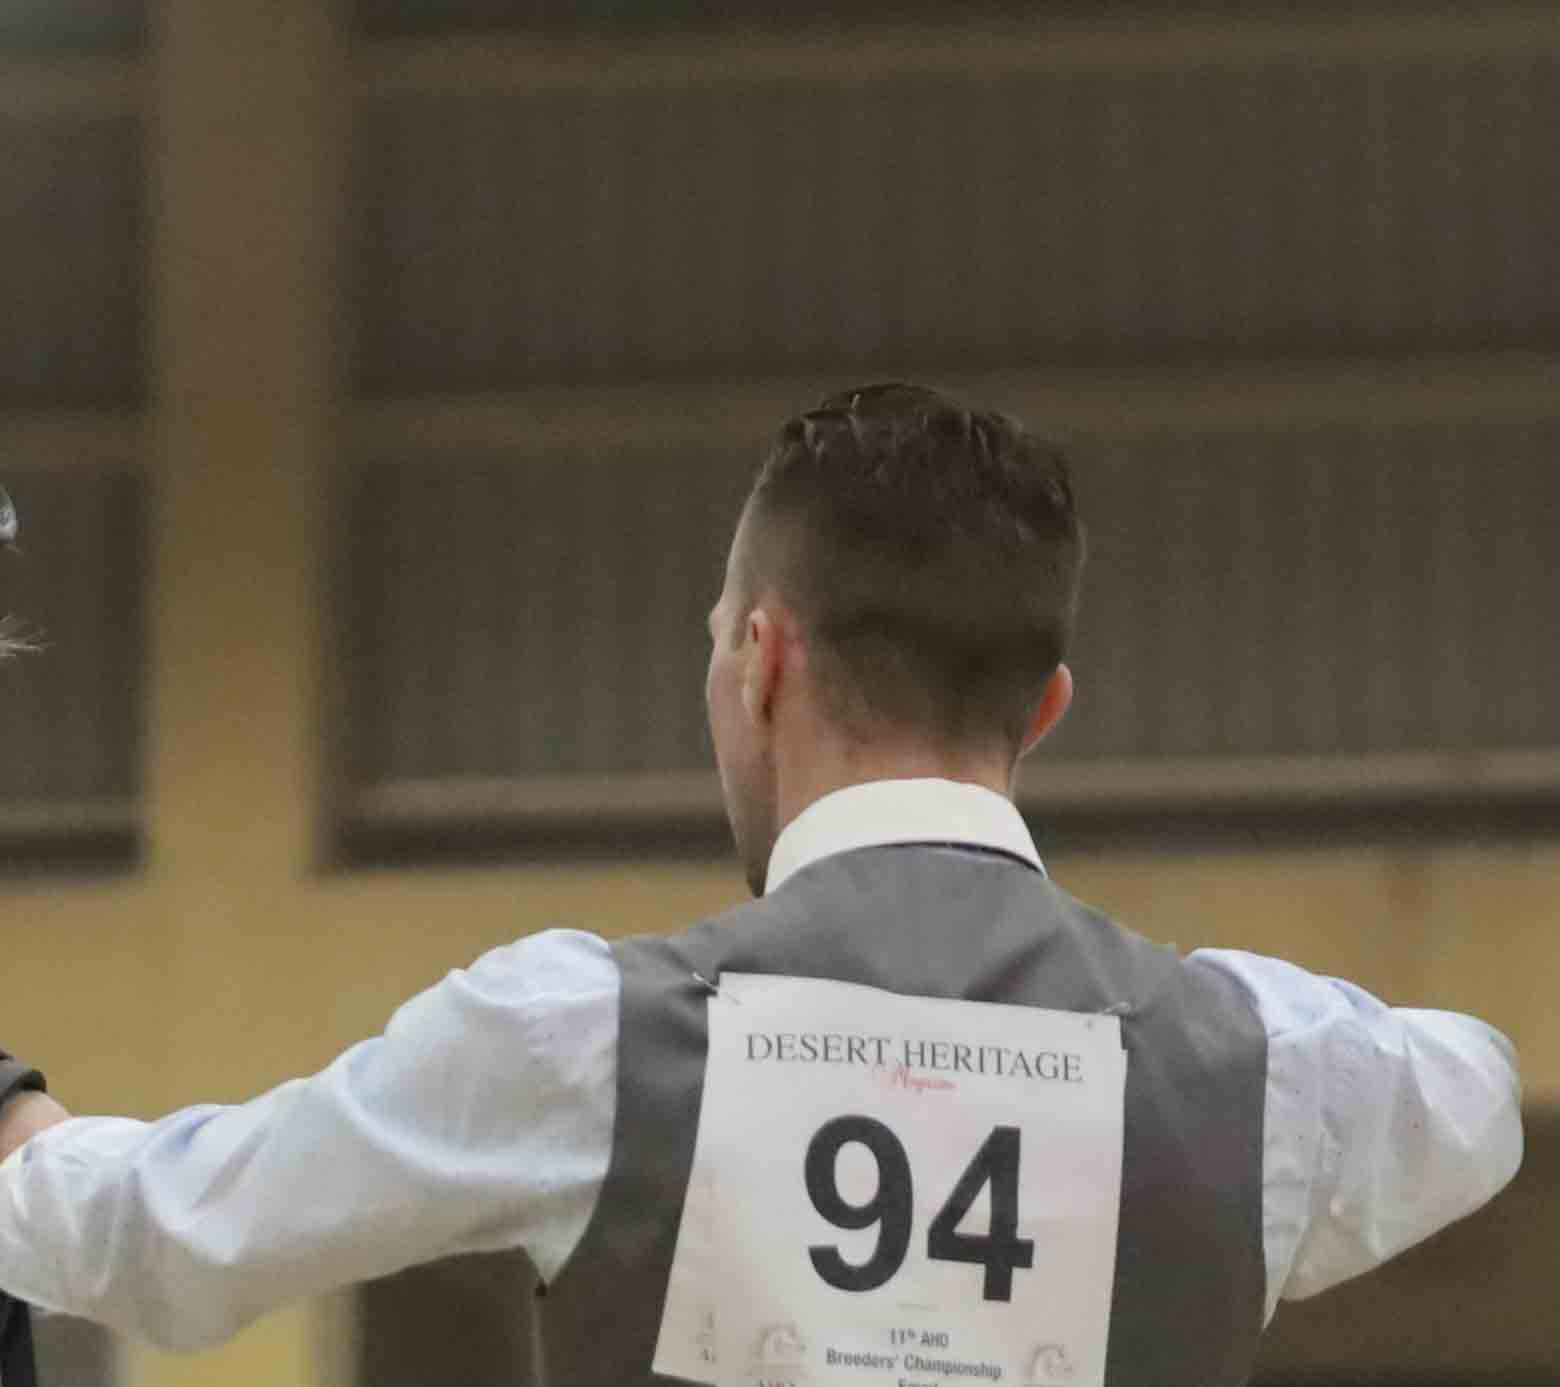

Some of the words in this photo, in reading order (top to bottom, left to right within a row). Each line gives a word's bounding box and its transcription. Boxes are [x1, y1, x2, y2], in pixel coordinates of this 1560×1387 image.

[745, 1031, 891, 1067] DESERT
[901, 1038, 1085, 1083] HERITAGE
[804, 1115, 1034, 1303] 94
[903, 1353, 1002, 1381] Championship
